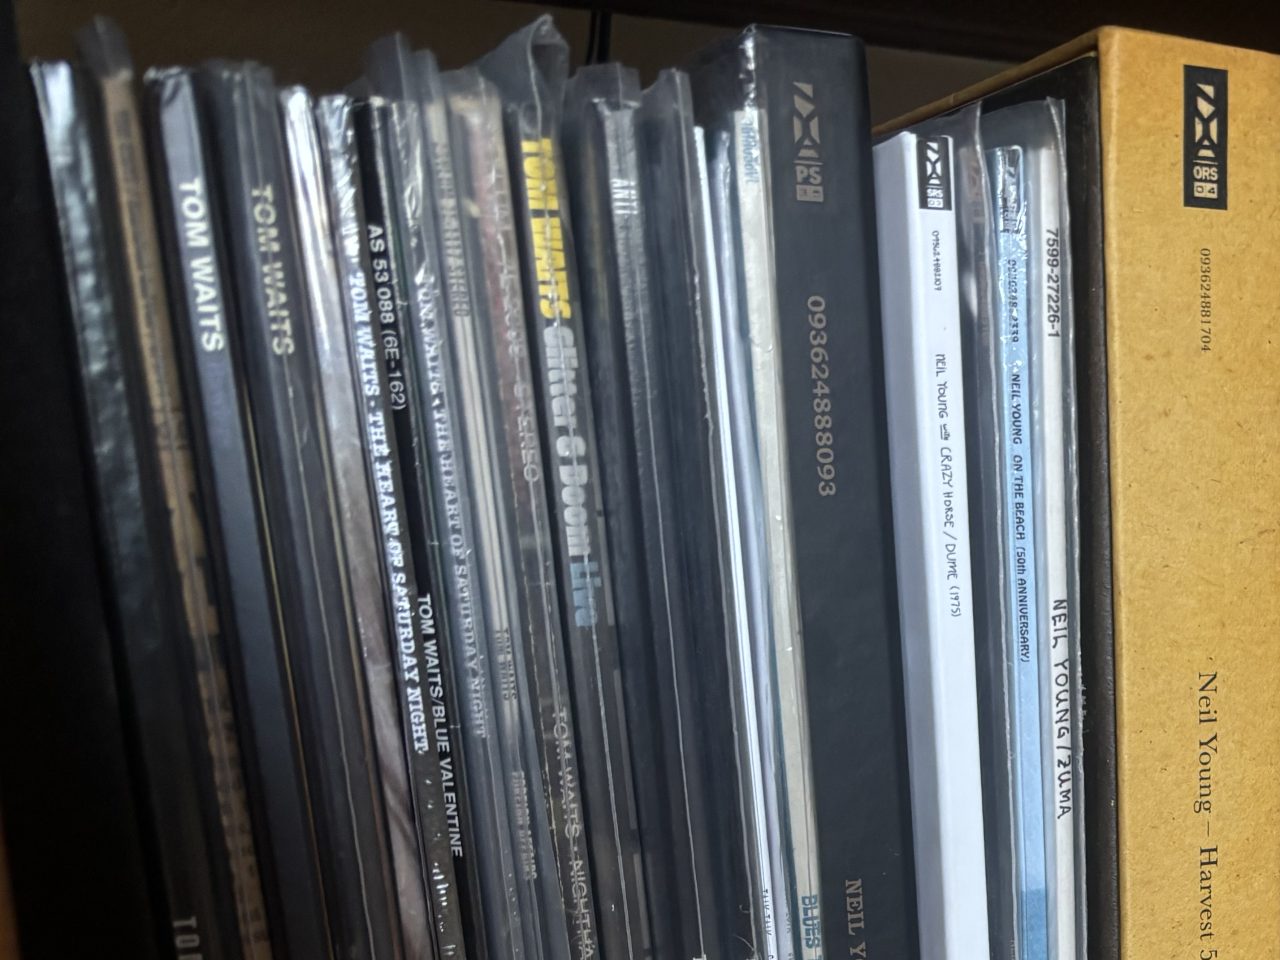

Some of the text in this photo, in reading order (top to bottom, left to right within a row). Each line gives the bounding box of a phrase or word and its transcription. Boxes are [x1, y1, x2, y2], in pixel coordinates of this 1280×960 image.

[178, 175, 210, 247] TOM
[1193, 167, 1218, 182] ORS
[1193, 183, 1217, 198] 04
[190, 256, 225, 352] WAITS
[251, 182, 295, 356] TOM WAITS
[1047, 227, 1060, 337] 7599-27226-1
[1199, 247, 1212, 352] 093624881704
[368, 224, 407, 410] AS 53 088 (6E-162)
[521, 137, 603, 627] TOM WAITS Glitter Doom Live
[807, 294, 837, 497] 093624888093
[935, 351, 947, 377] NEIL
[940, 444, 954, 487] CRAZY
[942, 490, 955, 527] HORSE
[348, 272, 430, 753] TOM WAITS THE HEART OF SATURDAY NIGHT
[1010, 372, 1031, 662] NEIL YOUNG ON THE BEACH (50th ANNIVERSARY)
[945, 542, 960, 579] DUME
[454, 564, 477, 668] SATURDAY
[1052, 599, 1068, 649] NEIL
[416, 593, 464, 857] TOM WAITS/BLUE VALENTINE
[1196, 671, 1218, 723] Neil
[1192, 731, 1218, 814] Young
[802, 894, 821, 948] BLUES
[844, 878, 864, 935] NEIL
[1197, 845, 1219, 940] Harvest
